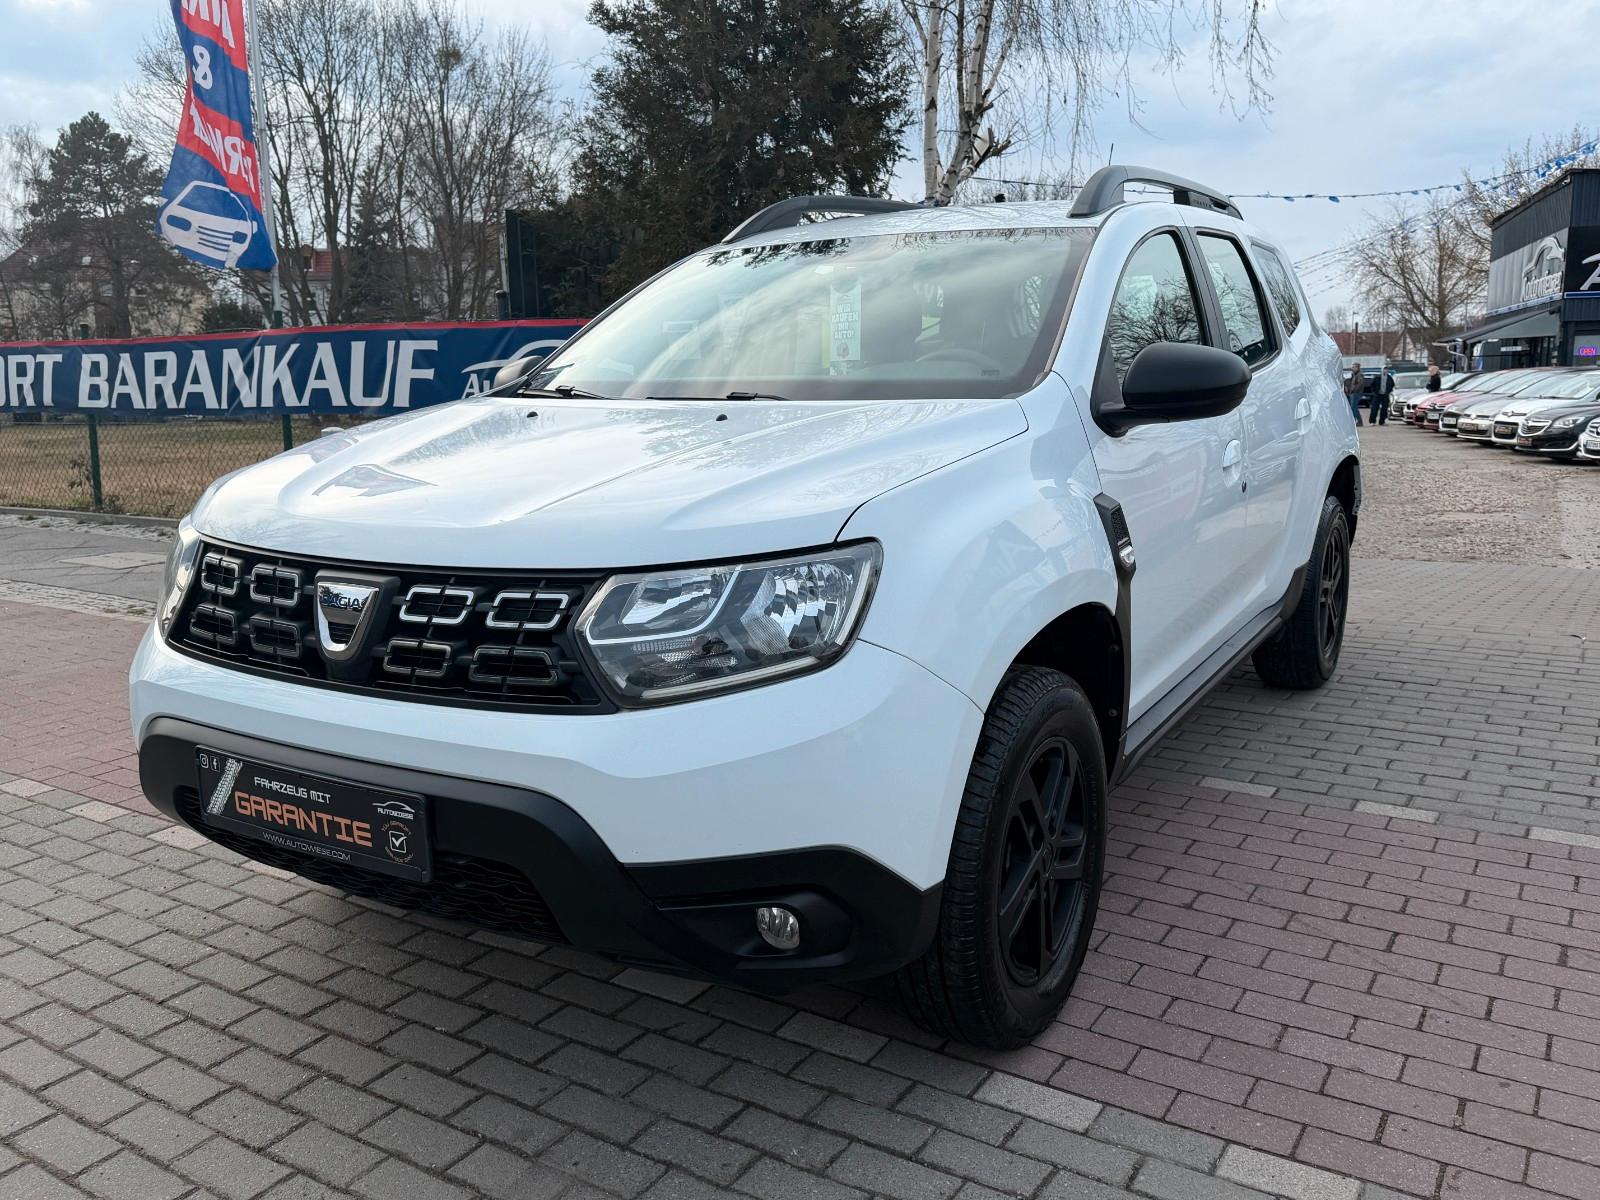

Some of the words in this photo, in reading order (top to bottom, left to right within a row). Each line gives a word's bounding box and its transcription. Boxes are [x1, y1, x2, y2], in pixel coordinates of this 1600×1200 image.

[0, 353, 63, 407] RT
[78, 340, 438, 410] BARANKAUF
[254, 776, 308, 799] FAHRZEUG
[310, 790, 331, 805] MIT
[234, 791, 373, 848] GARANTIE
